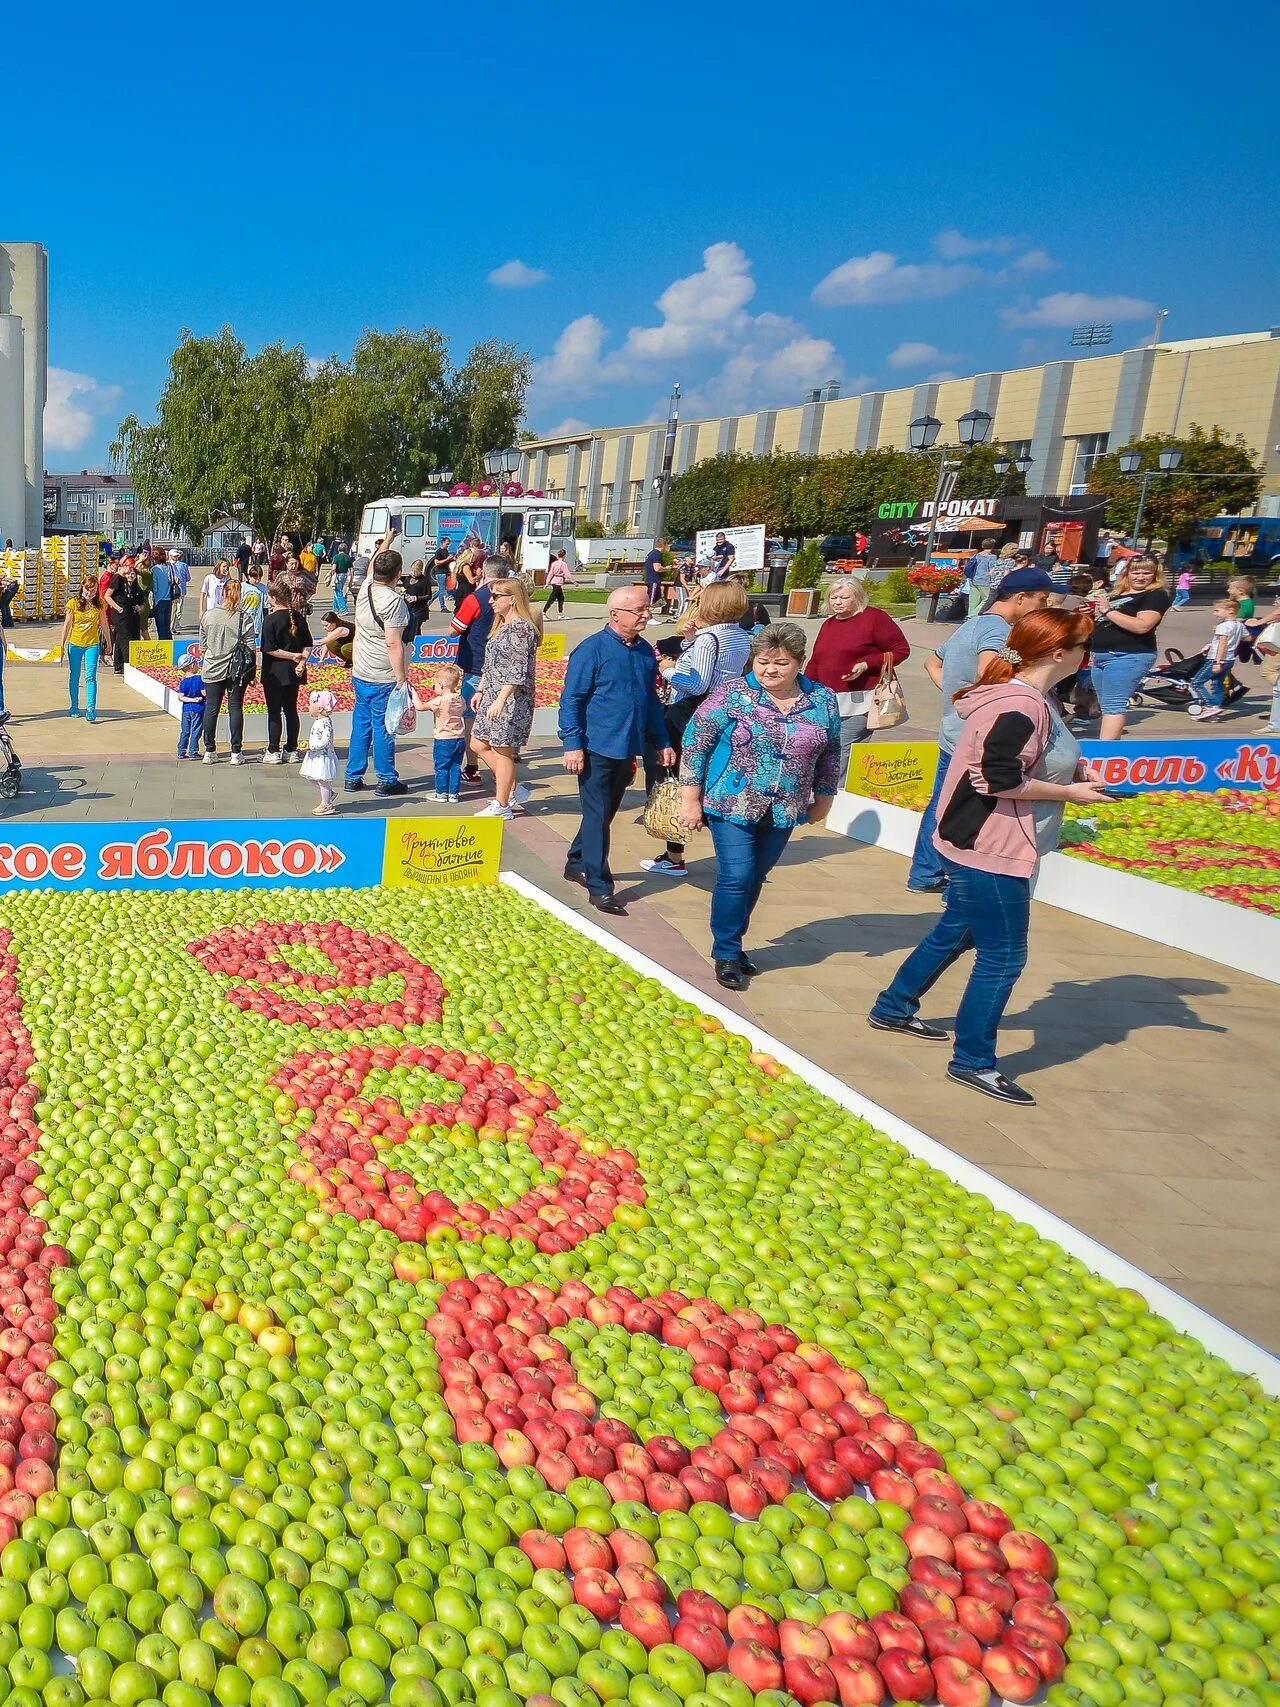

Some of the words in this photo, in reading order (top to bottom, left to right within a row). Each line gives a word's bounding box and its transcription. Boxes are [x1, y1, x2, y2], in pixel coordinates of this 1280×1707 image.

[878, 501, 919, 519] CITY
[922, 499, 997, 517] ПРОКАТ
[100, 830, 345, 878] яблоко»
[402, 825, 476, 858] Фруктовое
[403, 867, 441, 885] ВЫРАЩЕНЫ
[443, 873, 449, 884] В
[450, 867, 479, 882] ОБОЯНИ
[185, 918, 1070, 1706] 989
